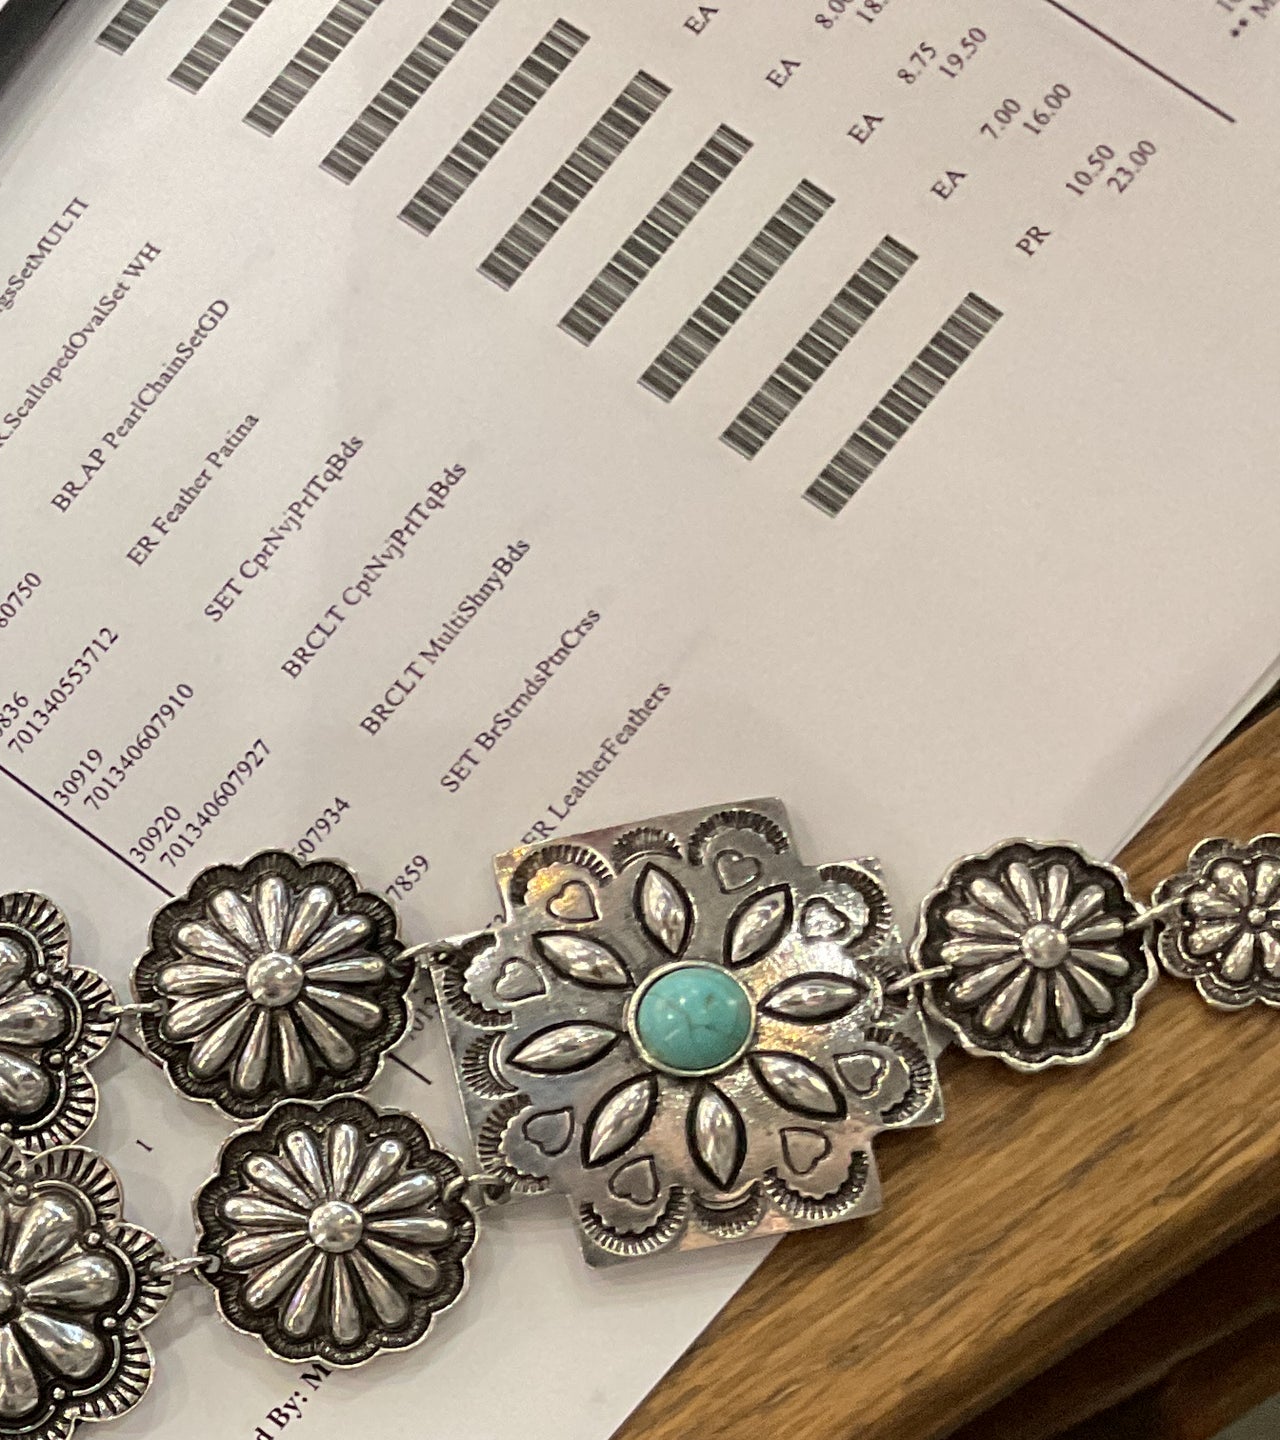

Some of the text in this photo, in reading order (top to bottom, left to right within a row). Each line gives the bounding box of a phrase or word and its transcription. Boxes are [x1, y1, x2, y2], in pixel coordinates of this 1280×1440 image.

[683, 5, 719, 35] EA
[814, 0, 853, 29] 8.0
[764, 59, 801, 88] EA
[897, 41, 936, 84] 8.75
[938, 26, 987, 78] 19.50
[846, 114, 884, 144] EA
[979, 98, 1021, 139] 7.00
[1022, 82, 1071, 135] 16.00
[929, 170, 967, 200] EA
[1065, 143, 1115, 196] 10.50
[1106, 139, 1157, 194] 23.00
[122, 241, 162, 277] WH
[1015, 225, 1051, 256] PR
[101, 299, 229, 450] PearlChainSetGD
[126, 414, 259, 566] ER Feather Patina
[204, 576, 243, 622] SET
[280, 604, 346, 679] BRCLT
[359, 539, 530, 736] BRCLT MultiShnyBds
[7, 627, 119, 753] 701340553712
[83, 683, 194, 810] 701340607910
[440, 747, 480, 793] SET
[547, 682, 671, 821] LeatherFeathers
[53, 748, 103, 806] 30919
[159, 737, 270, 867] 701340607927
[129, 805, 181, 863] 30920
[135, 1138, 153, 1152] 1
[265, 1390, 308, 1430] By:
